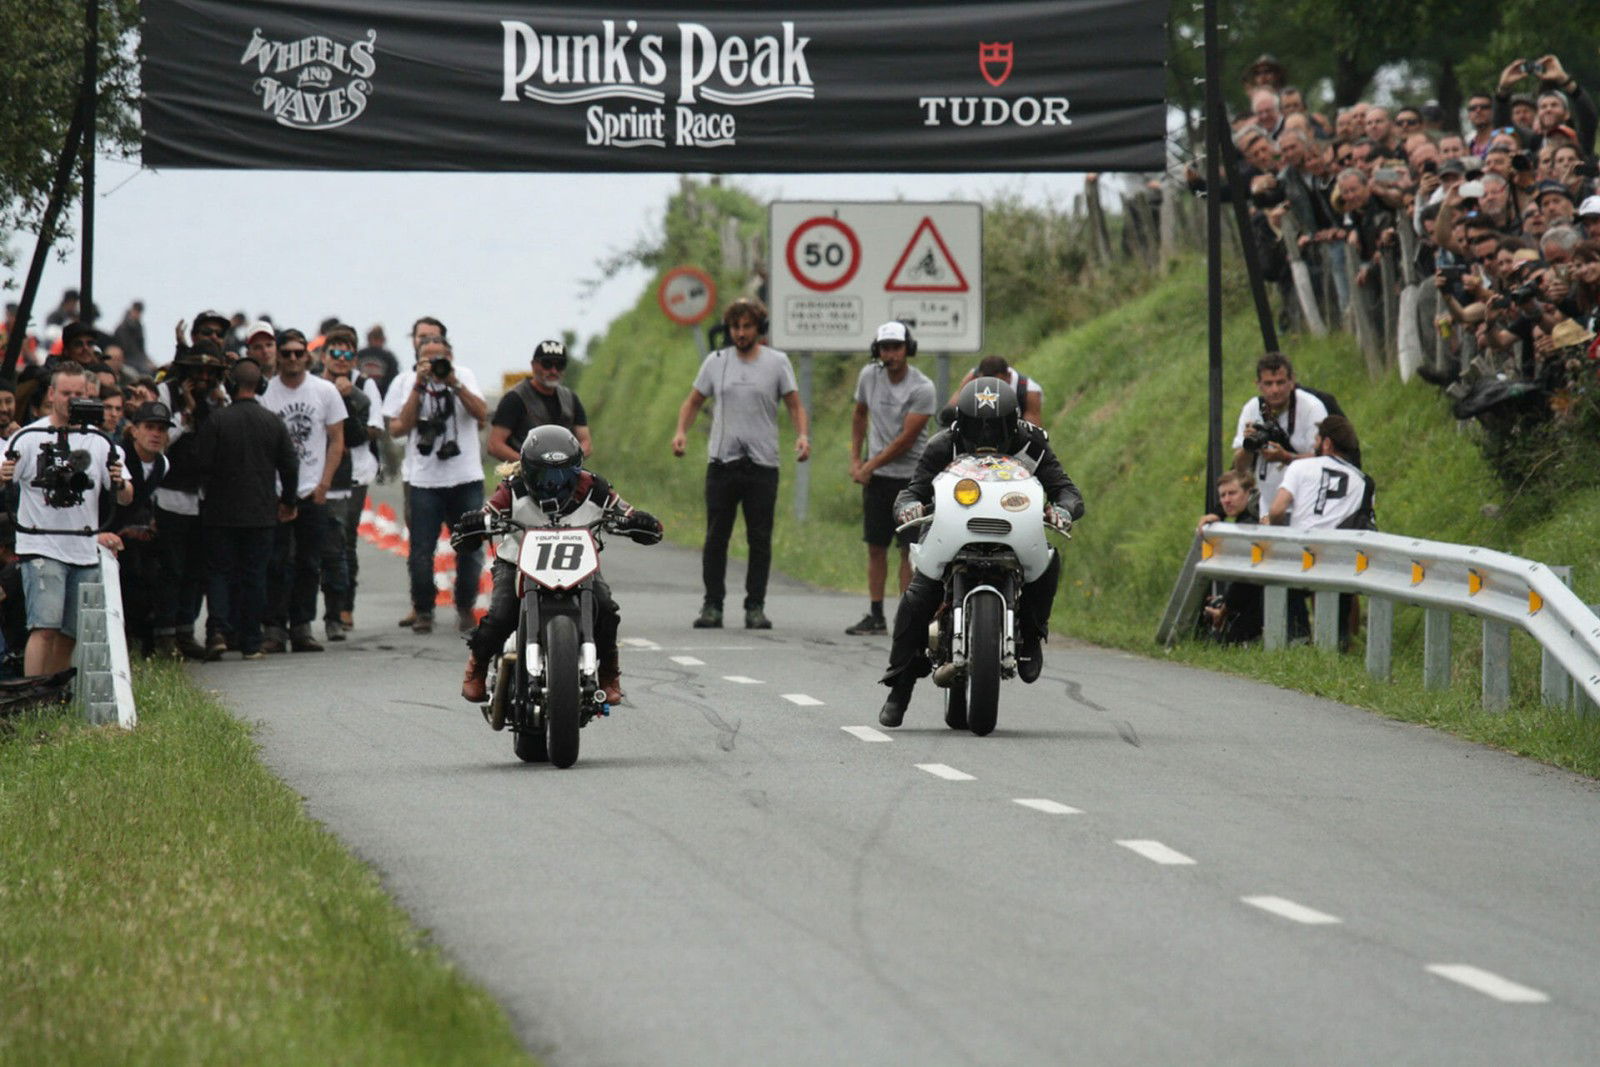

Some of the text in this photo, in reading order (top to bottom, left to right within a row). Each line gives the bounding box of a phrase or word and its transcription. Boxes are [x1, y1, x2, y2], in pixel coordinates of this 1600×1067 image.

[240, 27, 377, 79] WHEELS
[500, 19, 815, 104] Punk's Peak
[297, 65, 333, 86] AND
[253, 77, 374, 127] WAVES
[919, 96, 1072, 127] TUDOR
[586, 105, 736, 147] Sprint Race
[805, 243, 844, 267] 50
[535, 542, 585, 571] 18
